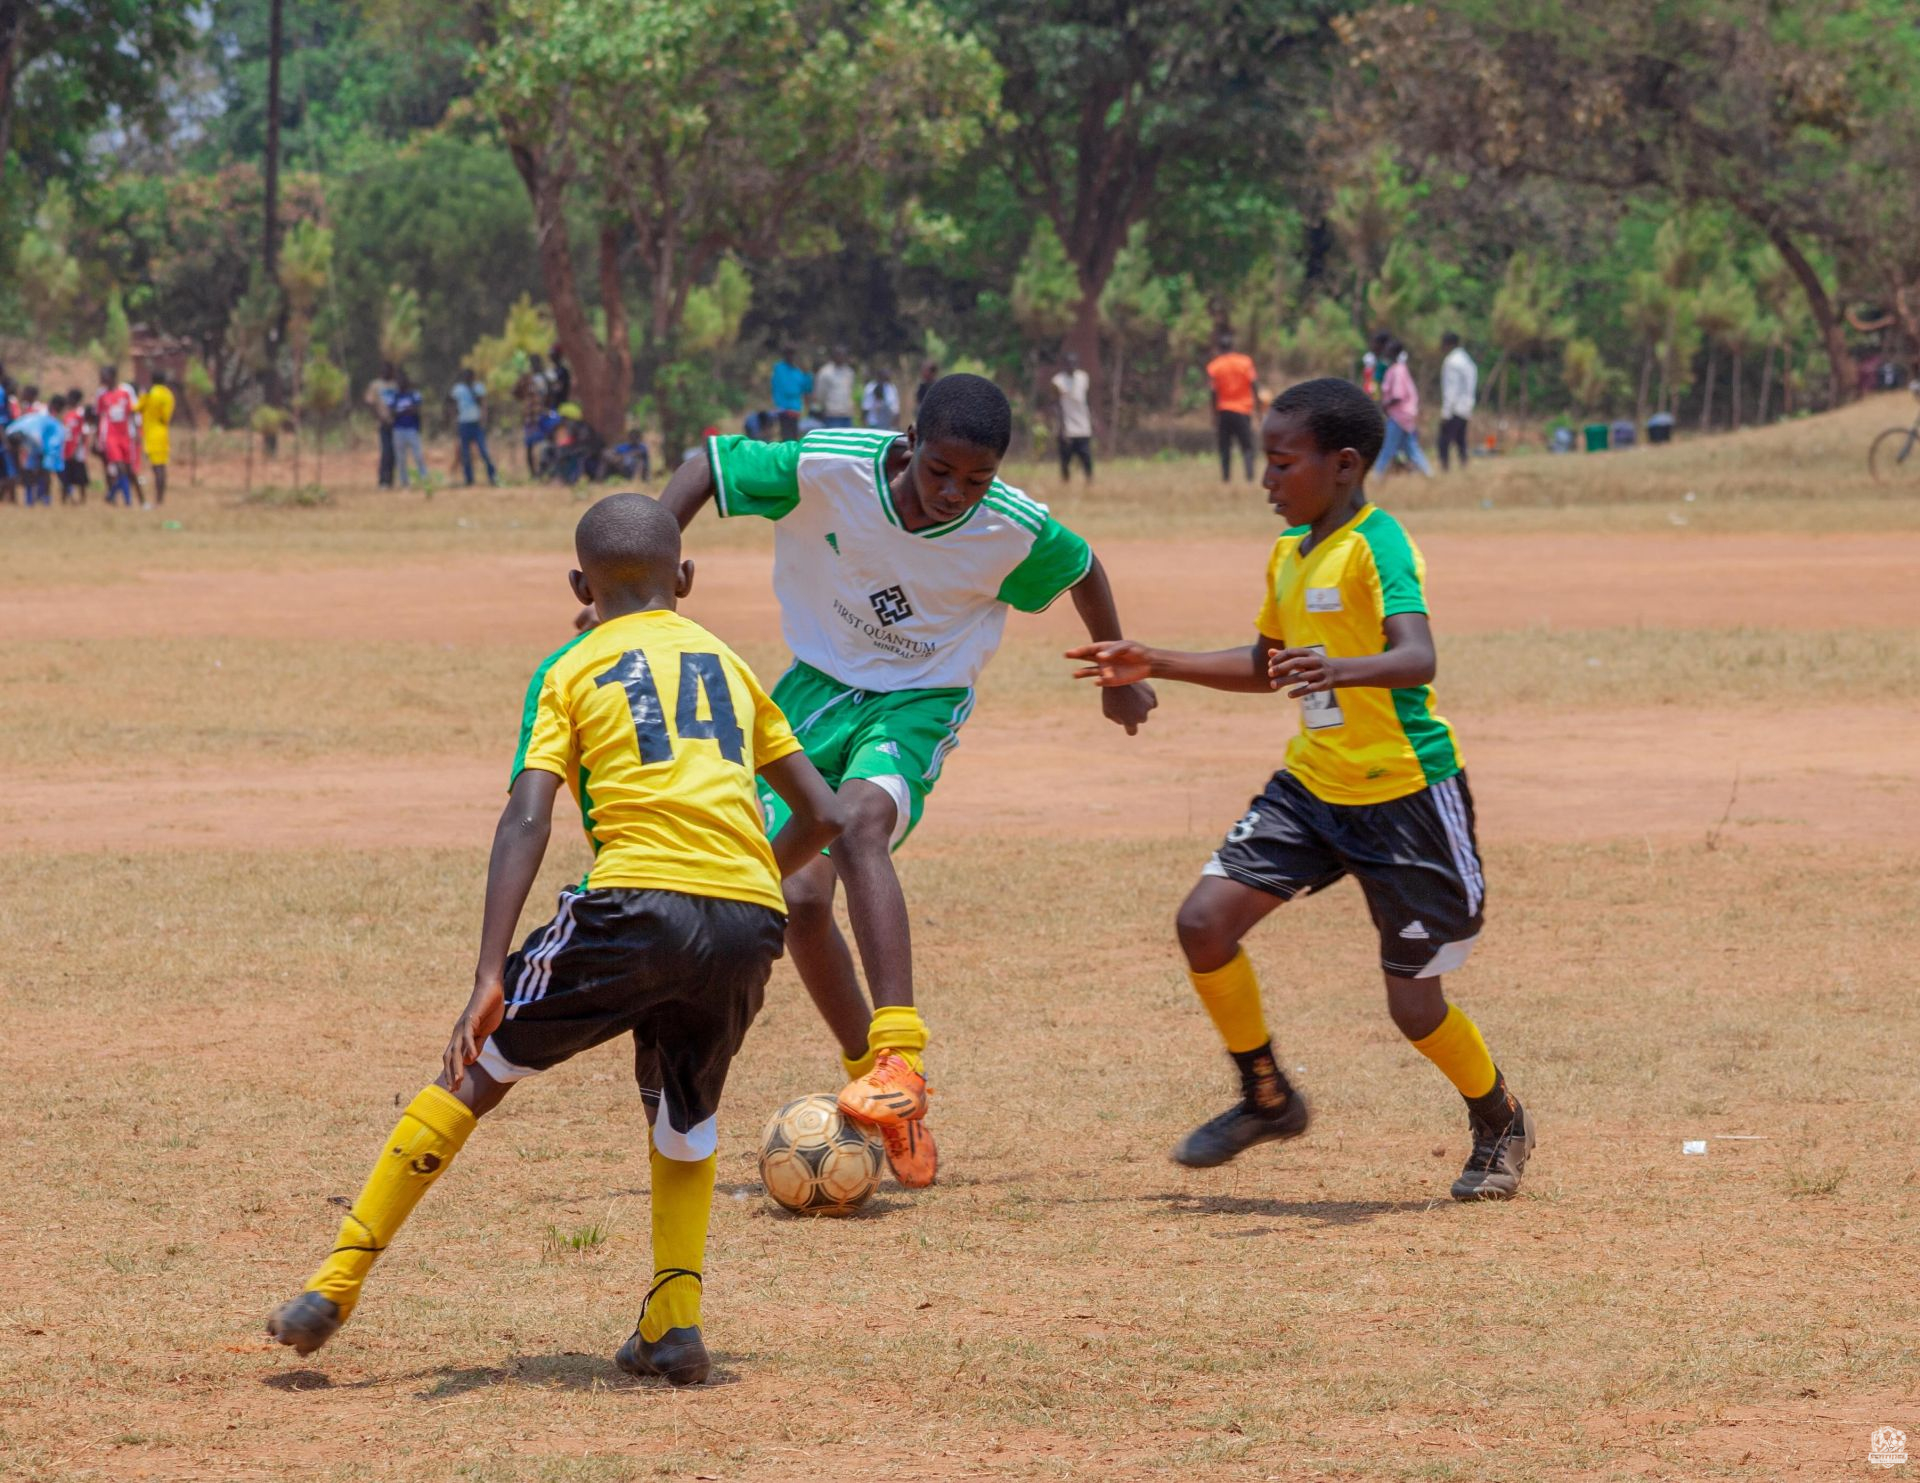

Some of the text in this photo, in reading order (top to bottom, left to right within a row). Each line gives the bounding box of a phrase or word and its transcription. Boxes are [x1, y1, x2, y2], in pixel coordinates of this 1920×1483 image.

[833, 599, 936, 654] FIRST QUANTUM
[593, 648, 746, 767] 14
